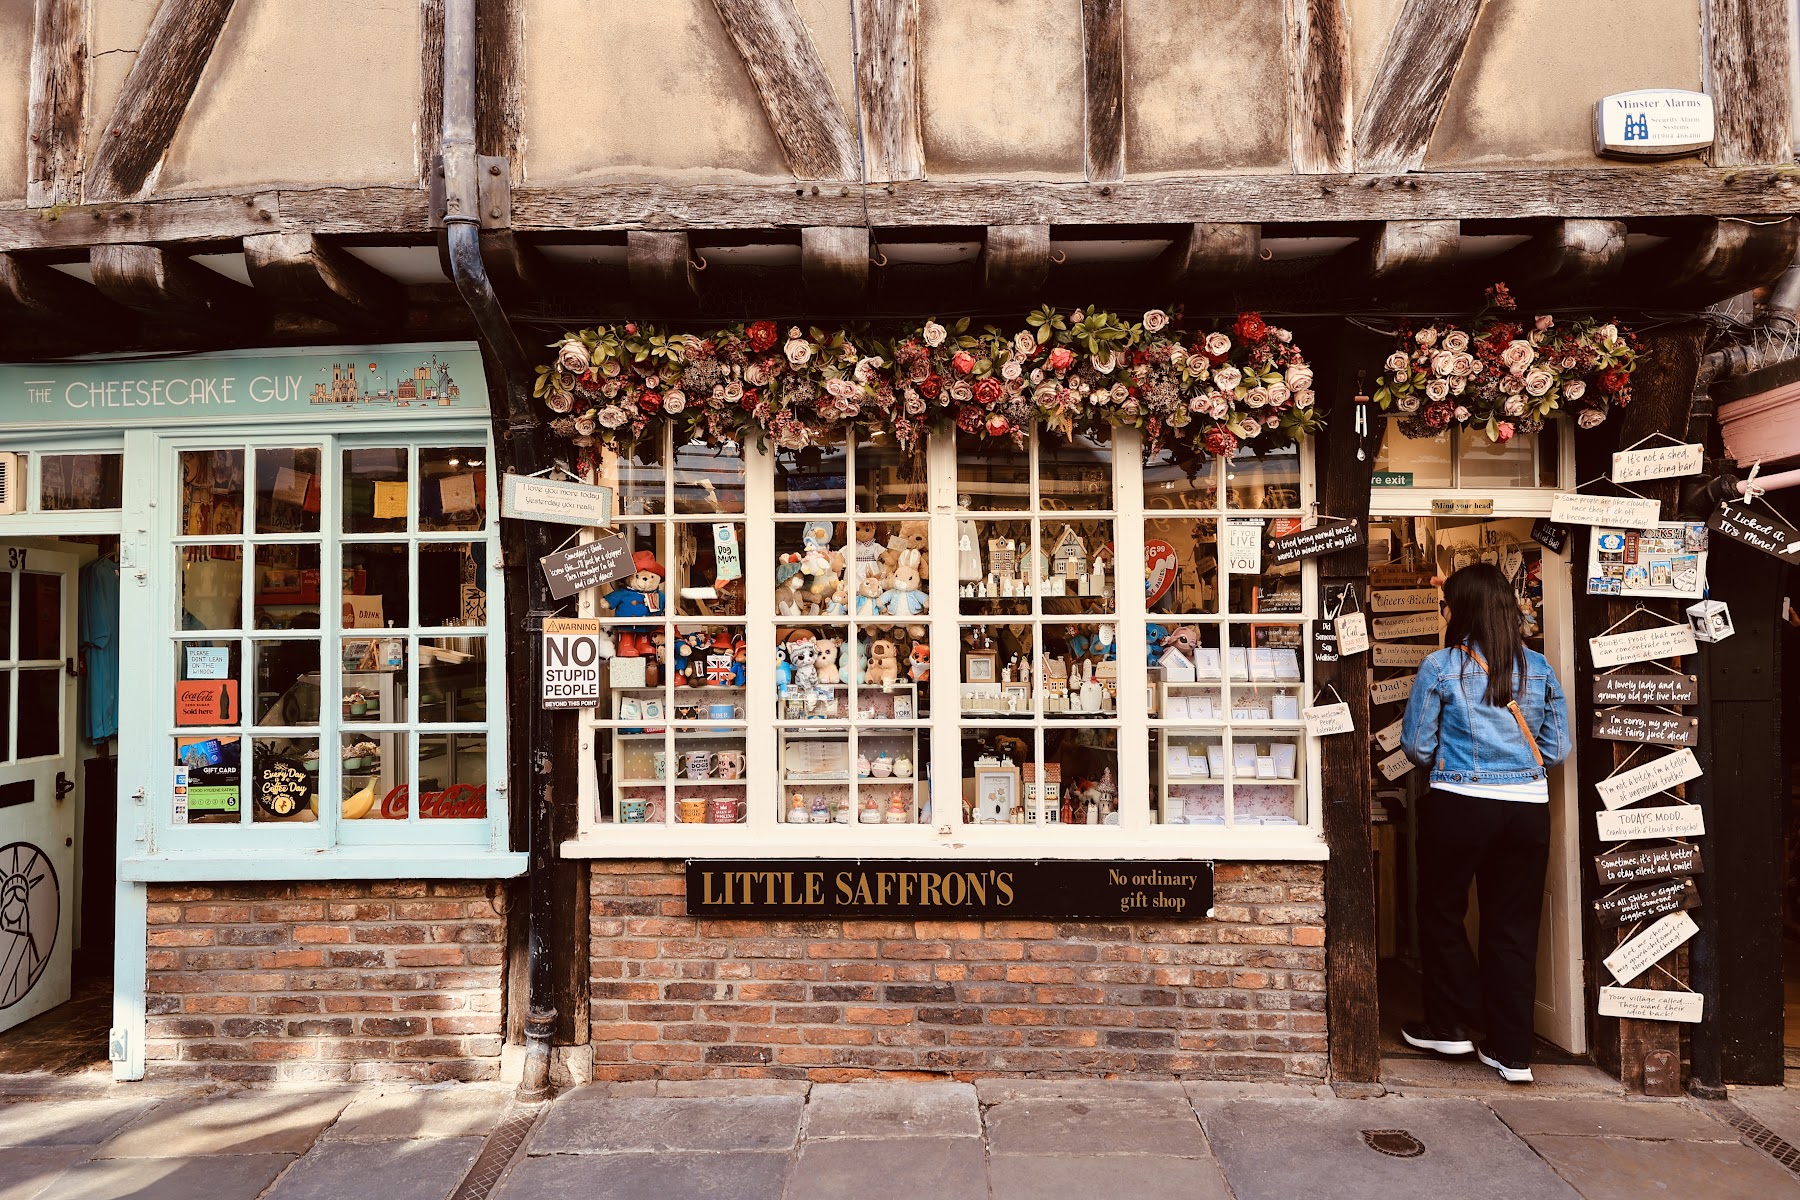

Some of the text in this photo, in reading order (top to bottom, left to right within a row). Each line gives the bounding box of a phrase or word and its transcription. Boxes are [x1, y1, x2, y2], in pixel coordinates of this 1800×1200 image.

[1617, 99, 1701, 109] Minster Alarms
[28, 376, 302, 408] THE CHEESECAKE GUY
[1628, 454, 1640, 464] It's
[1644, 452, 1656, 462] not
[1620, 468, 1633, 478] It's
[1645, 464, 1675, 475] fcking
[1679, 460, 1696, 472] bar!
[1385, 476, 1406, 484] exit
[528, 484, 542, 492] love
[560, 488, 577, 497] more
[581, 492, 599, 500] today
[526, 497, 560, 508] Yesterday
[1722, 507, 1733, 517] I
[1733, 512, 1773, 534] Licked
[1281, 538, 1297, 549] tried
[1297, 535, 1314, 545] being
[1315, 528, 1335, 540] normal
[1640, 529, 1685, 539] YORKSHI
[1230, 537, 1255, 546] LIVE
[1302, 543, 1325, 555] minutes
[1326, 539, 1333, 548] of
[1334, 539, 1344, 548] my
[1744, 532, 1776, 551] Mine!
[718, 546, 731, 555] Dog
[8, 548, 27, 570] 37
[1230, 560, 1254, 569] YOU
[1377, 595, 1404, 607] Cheers
[359, 610, 380, 619] DRINK
[547, 637, 596, 667] NO
[1322, 643, 1332, 652] Say
[546, 670, 596, 681] STUPID
[546, 684, 596, 696] PEOPLE
[1379, 681, 1408, 692] Dad's
[1607, 680, 1612, 690] A
[1615, 680, 1636, 691] lovely
[1639, 681, 1656, 691] lady
[1659, 681, 1674, 690] and
[1598, 691, 1691, 702] grumpy old git live here!
[1610, 715, 1621, 723] I'm
[1649, 721, 1660, 730] my
[1663, 720, 1678, 730] give
[1607, 726, 1622, 735] shit
[1625, 727, 1645, 739] fairy
[1646, 729, 1665, 740] just
[1667, 731, 1689, 742] died!
[264, 768, 306, 782] Every Day
[262, 782, 307, 796] Coffee Day
[1640, 854, 1651, 864] it's
[1653, 851, 1669, 865] just
[1670, 849, 1693, 860] better
[1607, 860, 1692, 880] to stay silent and smile!
[1108, 869, 1198, 890] No ordinary
[701, 870, 1014, 906] LITTLE SAFFRON'S
[1120, 892, 1186, 912] gift shop
[1602, 901, 1615, 910] It's
[1617, 898, 1627, 906] all
[1628, 893, 1649, 903] Shits
[1658, 883, 1685, 896] Giggles
[1622, 895, 1672, 912] until someone
[1620, 910, 1647, 922] Giggles
[1656, 901, 1679, 912] Shits!
[1629, 994, 1655, 1002] village
